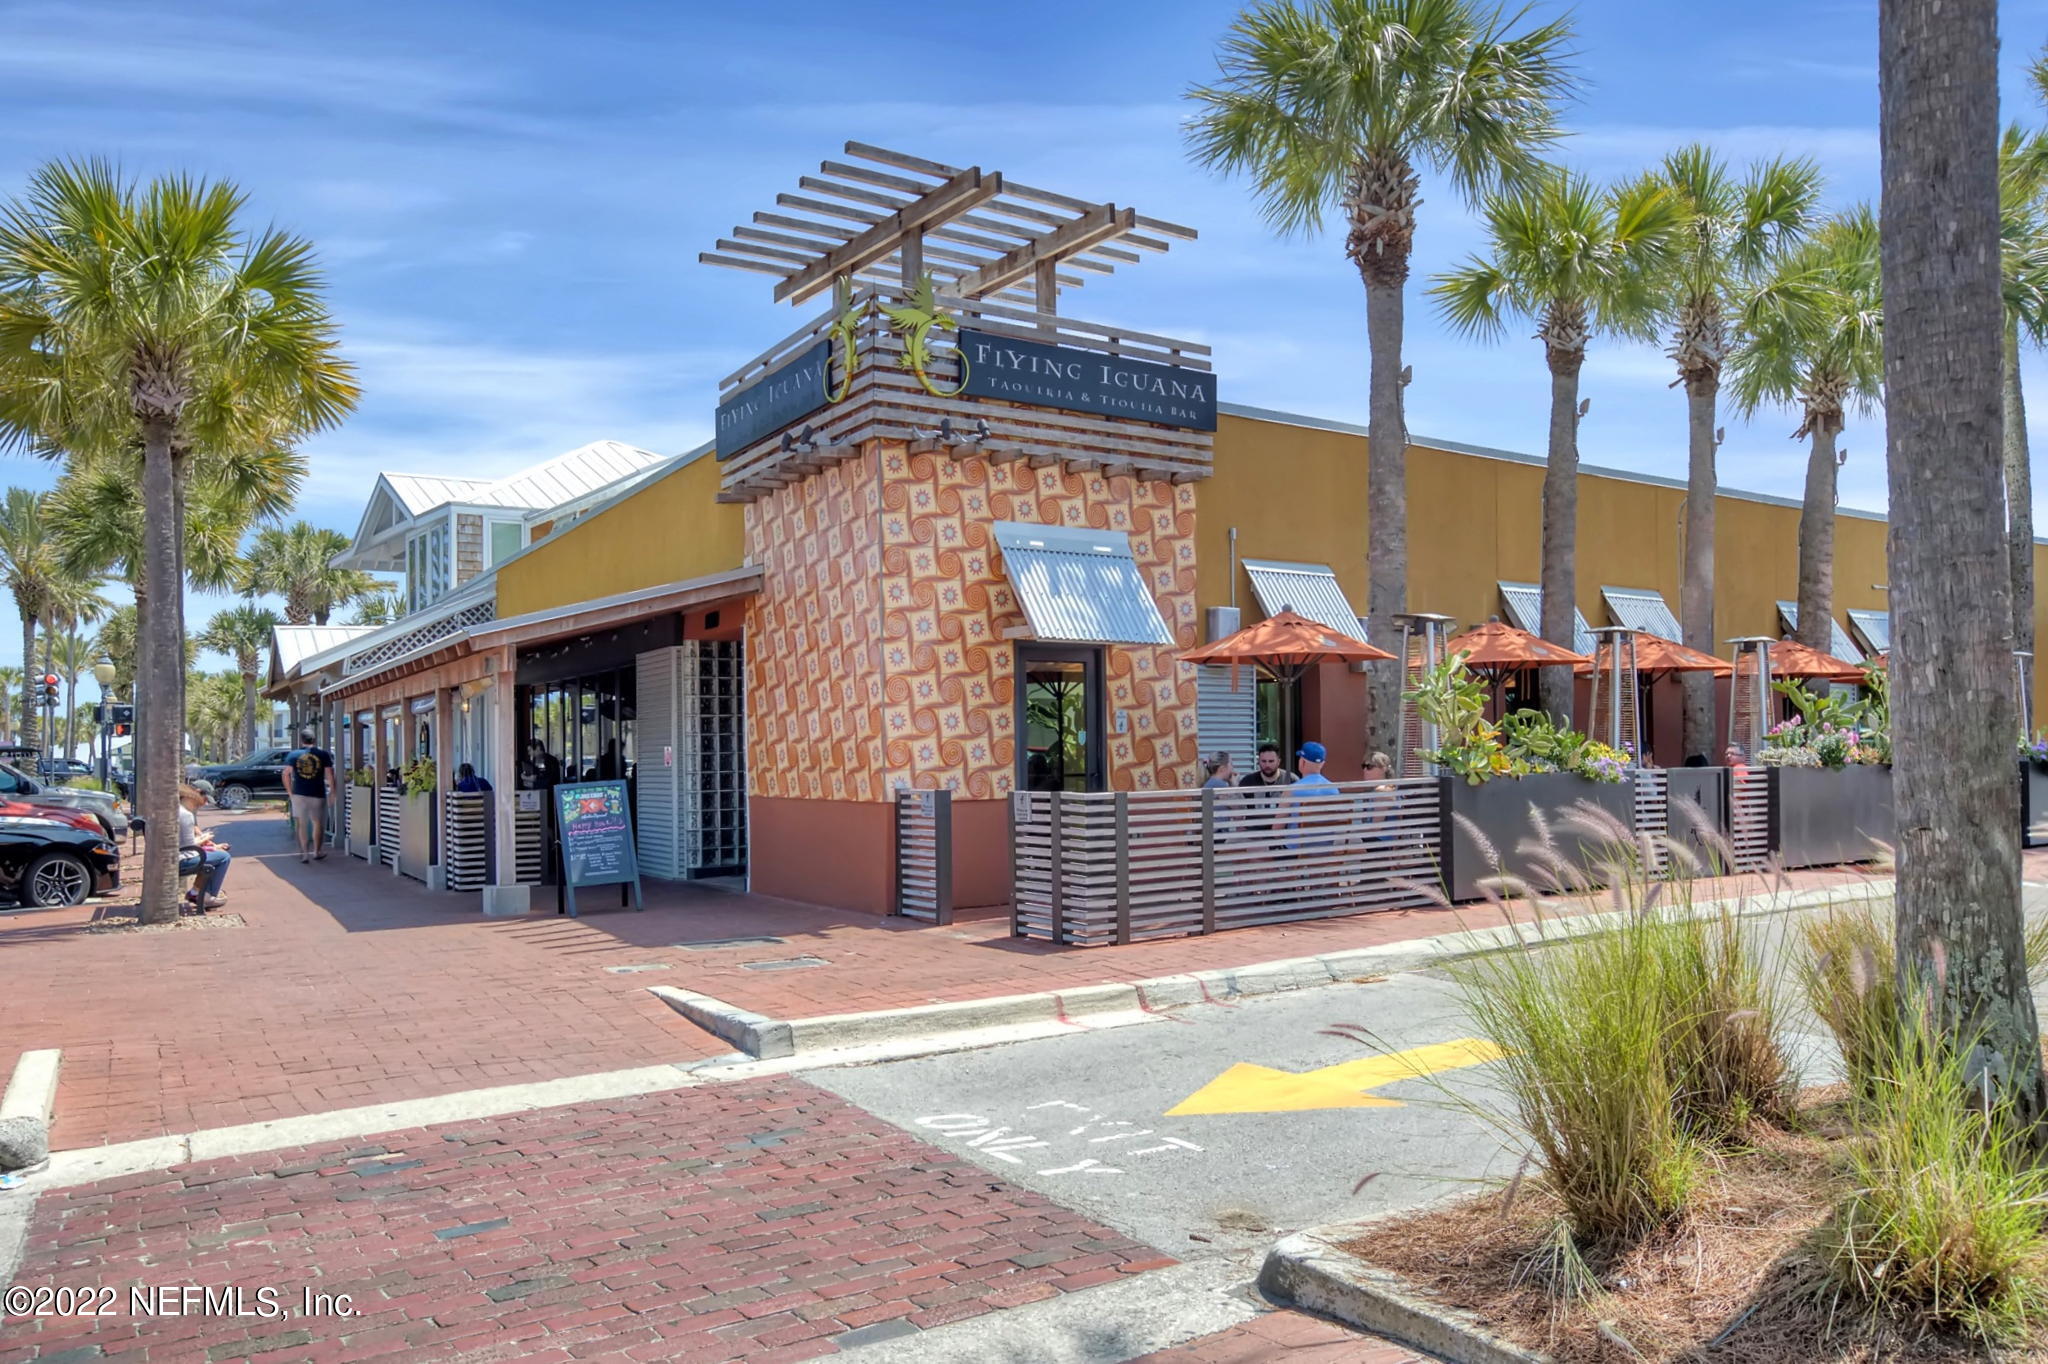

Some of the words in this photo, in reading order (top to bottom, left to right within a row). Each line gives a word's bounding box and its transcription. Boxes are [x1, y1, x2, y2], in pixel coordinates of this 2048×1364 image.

[976, 343, 1082, 379] FLYING
[1100, 365, 1207, 402] IGUANA
[1081, 391, 1091, 403] &
[1171, 406, 1198, 421] BAR
[914, 1113, 1126, 1176] ONLY
